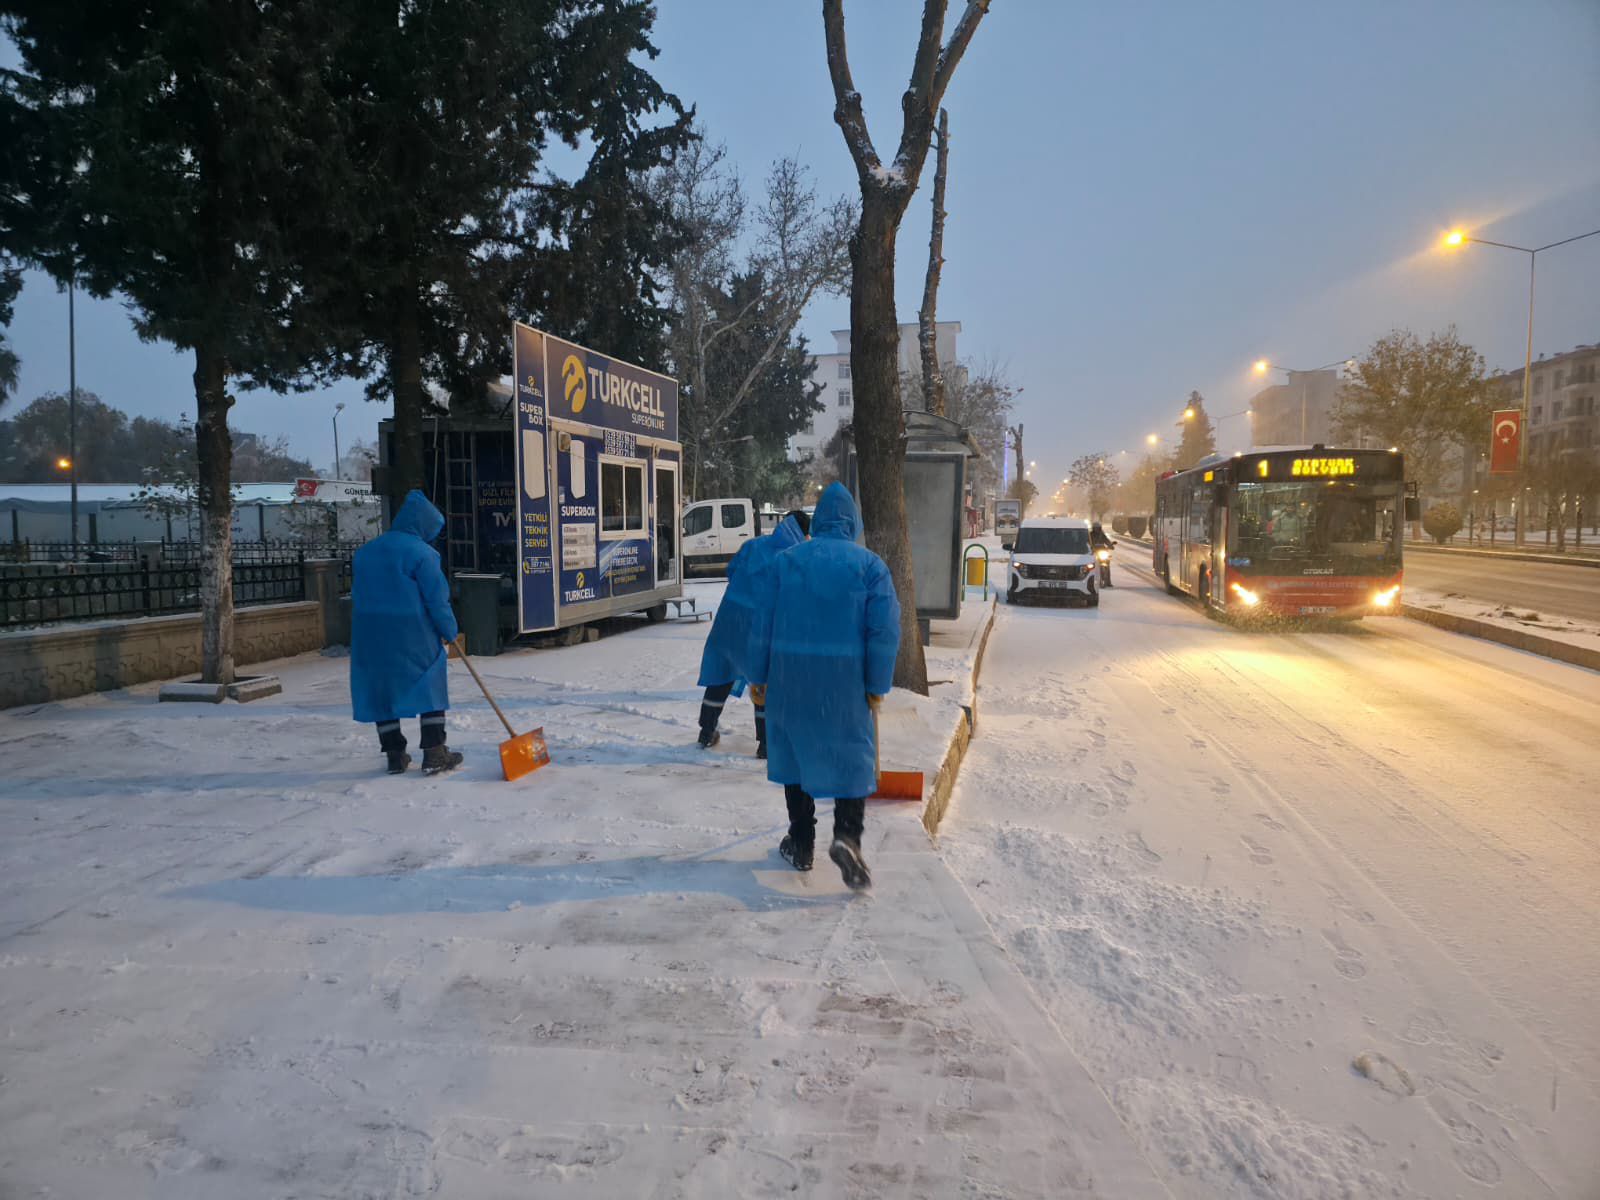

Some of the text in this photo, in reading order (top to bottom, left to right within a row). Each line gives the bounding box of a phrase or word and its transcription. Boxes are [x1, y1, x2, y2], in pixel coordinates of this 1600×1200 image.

[588, 366, 665, 417] TURKCELL
[520, 401, 543, 416] SUPER
[529, 413, 544, 426] BOX
[1258, 459, 1268, 477] 1
[561, 505, 596, 517] SUPERBOX
[564, 587, 596, 602] TURKCELL
